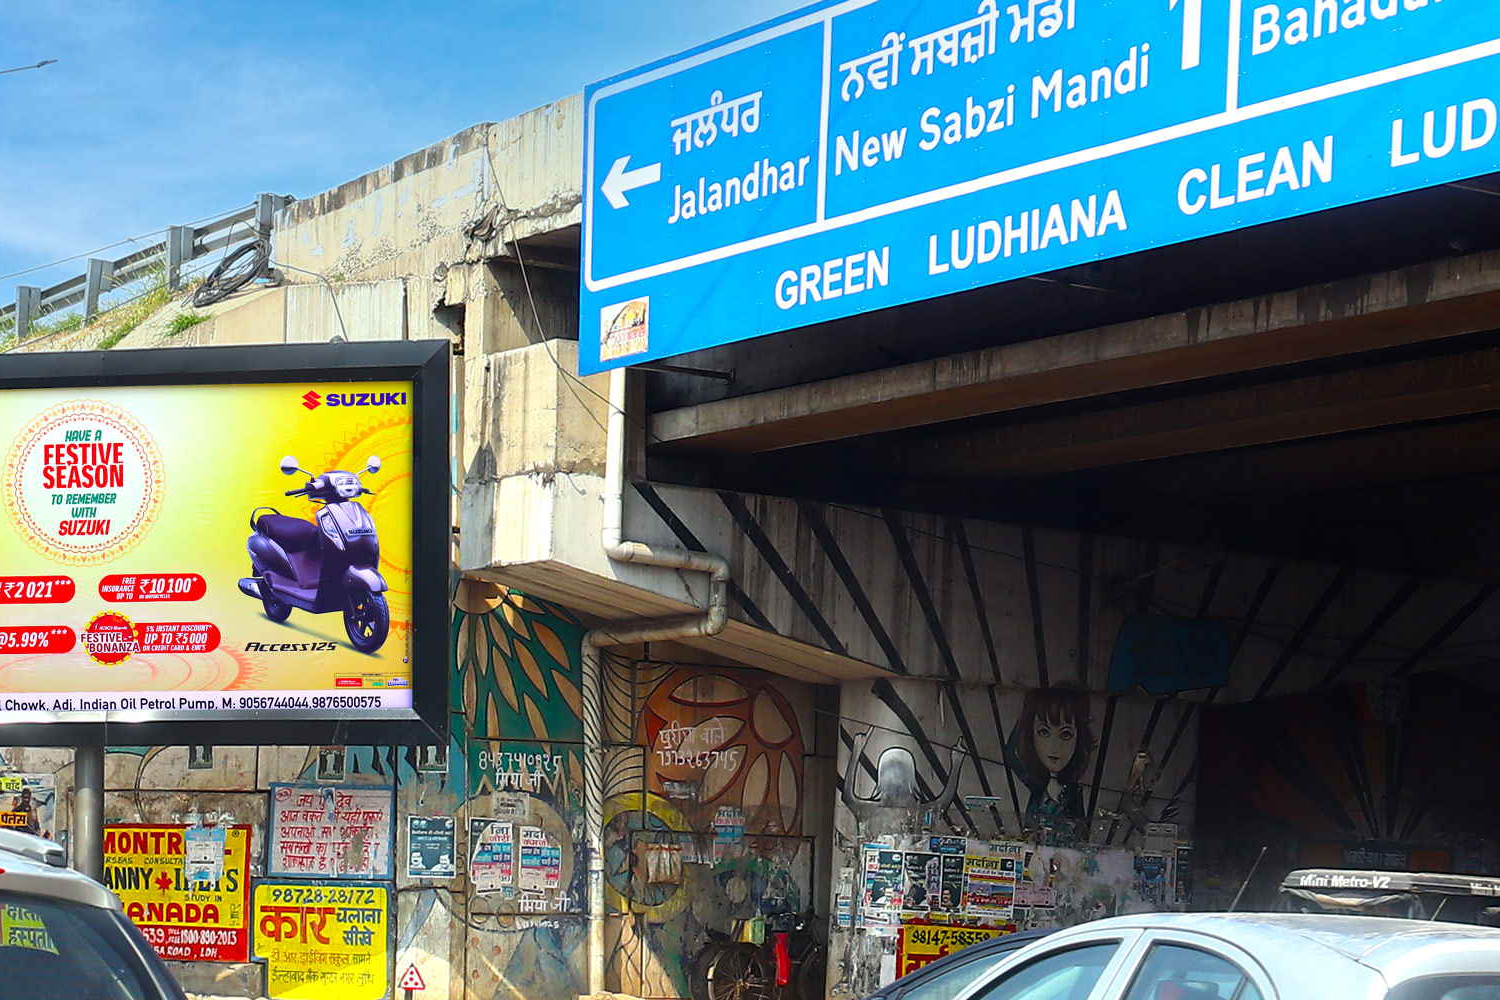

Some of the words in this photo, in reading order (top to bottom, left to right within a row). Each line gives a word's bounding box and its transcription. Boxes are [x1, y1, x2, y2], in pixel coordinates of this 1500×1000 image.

[834, 127, 908, 177] New
[918, 84, 1016, 152] Sabzi
[1030, 42, 1151, 120] Mandi
[670, 89, 763, 156] ਜਲੰਧਰ
[667, 155, 811, 224] Jalandhar
[775, 246, 890, 310] GREEN
[928, 189, 1128, 276] LUDHIANA
[1177, 134, 1334, 216] CLEAN
[1390, 97, 1498, 168] LUD
[326, 392, 407, 406] SUZUKI
[65, 430, 92, 442] HAVE
[94, 429, 103, 441] A
[43, 442, 124, 466] FESTIVE
[42, 464, 124, 489] SEASON
[51, 494, 63, 505] TO
[65, 493, 117, 505] REMEMBER
[71, 507, 97, 518] WITH
[58, 519, 111, 536] SUZUKI
[101, 584, 135, 593] INSURANCE
[116, 592, 124, 600] UP
[125, 592, 134, 600] TO
[81, 632, 122, 644] FESTIVE
[144, 633, 158, 644] UP
[160, 633, 172, 644] TO
[88, 642, 140, 653] BONANZA
[80, 698, 117, 710] Indian
[120, 698, 136, 709] Oil
[140, 698, 176, 709] Petrol
[222, 697, 235, 709] M:
[1300, 873, 1329, 886] Mini
[1331, 875, 1390, 889] Metro-V2
[184, 894, 211, 902] STUDY
[272, 888, 375, 904] 98728-28172
[260, 905, 336, 945] कार
[336, 906, 383, 924] चलाना
